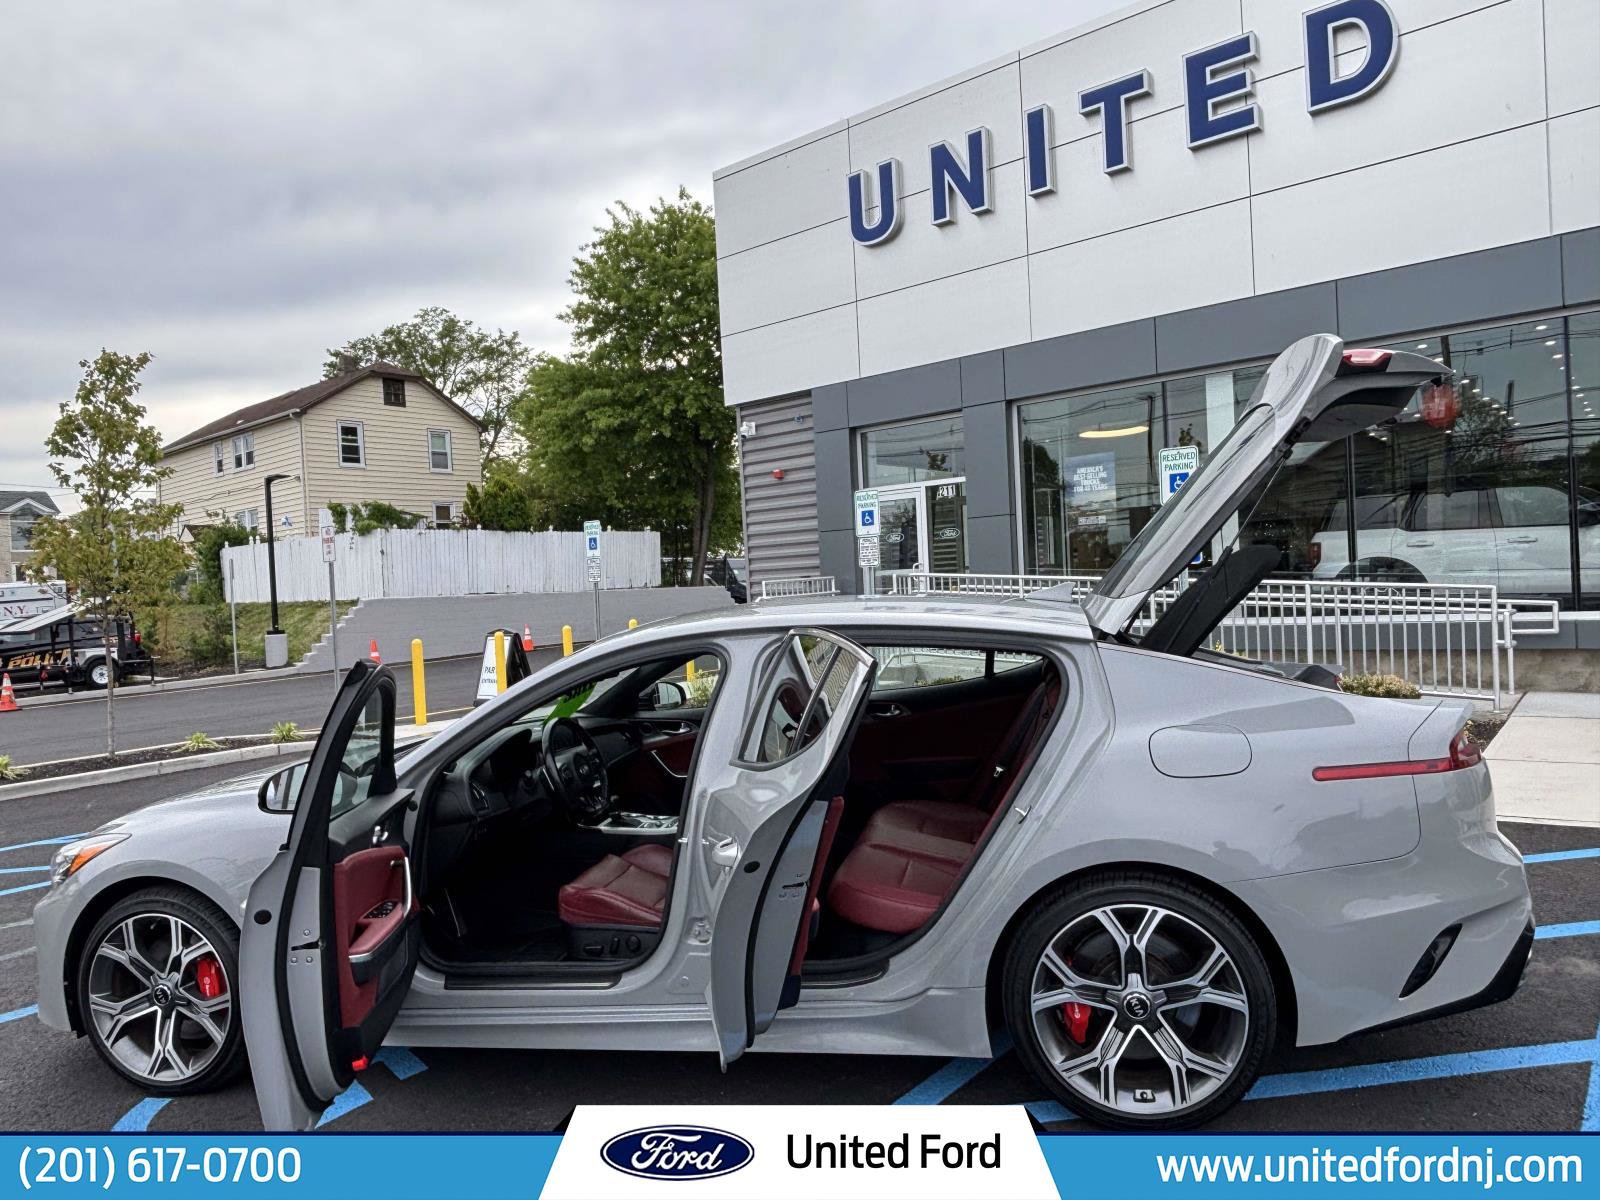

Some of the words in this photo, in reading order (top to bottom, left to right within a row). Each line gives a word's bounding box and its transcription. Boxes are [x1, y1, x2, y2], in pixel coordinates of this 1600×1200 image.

[846, 0, 1401, 247] UNITED
[1162, 452, 1196, 462] RESERVED
[1164, 462, 1194, 471] PARKING
[1129, 998, 1144, 1016] KIA
